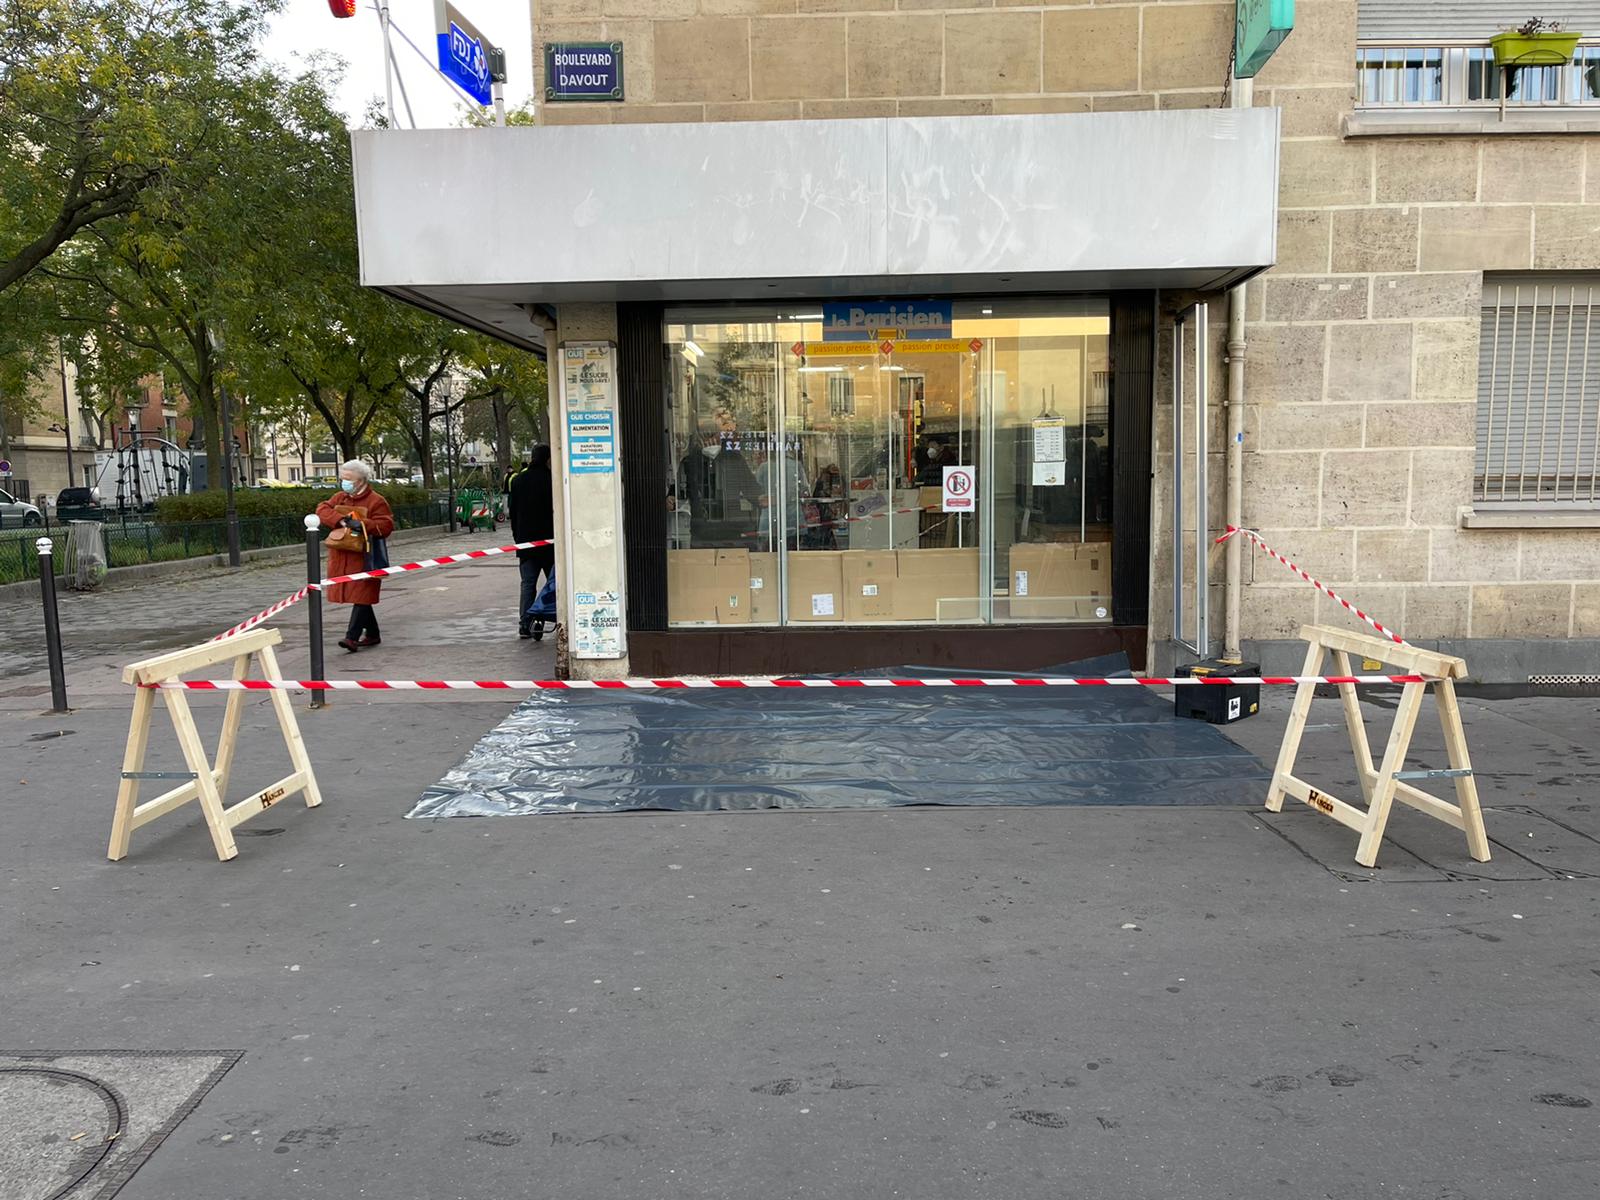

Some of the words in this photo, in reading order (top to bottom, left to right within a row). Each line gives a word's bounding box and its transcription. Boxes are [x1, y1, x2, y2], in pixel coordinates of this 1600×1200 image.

[453, 31, 471, 62] FDJ
[555, 53, 612, 66] BOULEVARD
[560, 74, 608, 86] DAVOUT
[832, 313, 847, 328] le
[849, 305, 943, 328] Parisien
[813, 344, 843, 353] passion
[846, 343, 871, 353] presse
[902, 342, 931, 352] passion
[935, 342, 960, 352] presse
